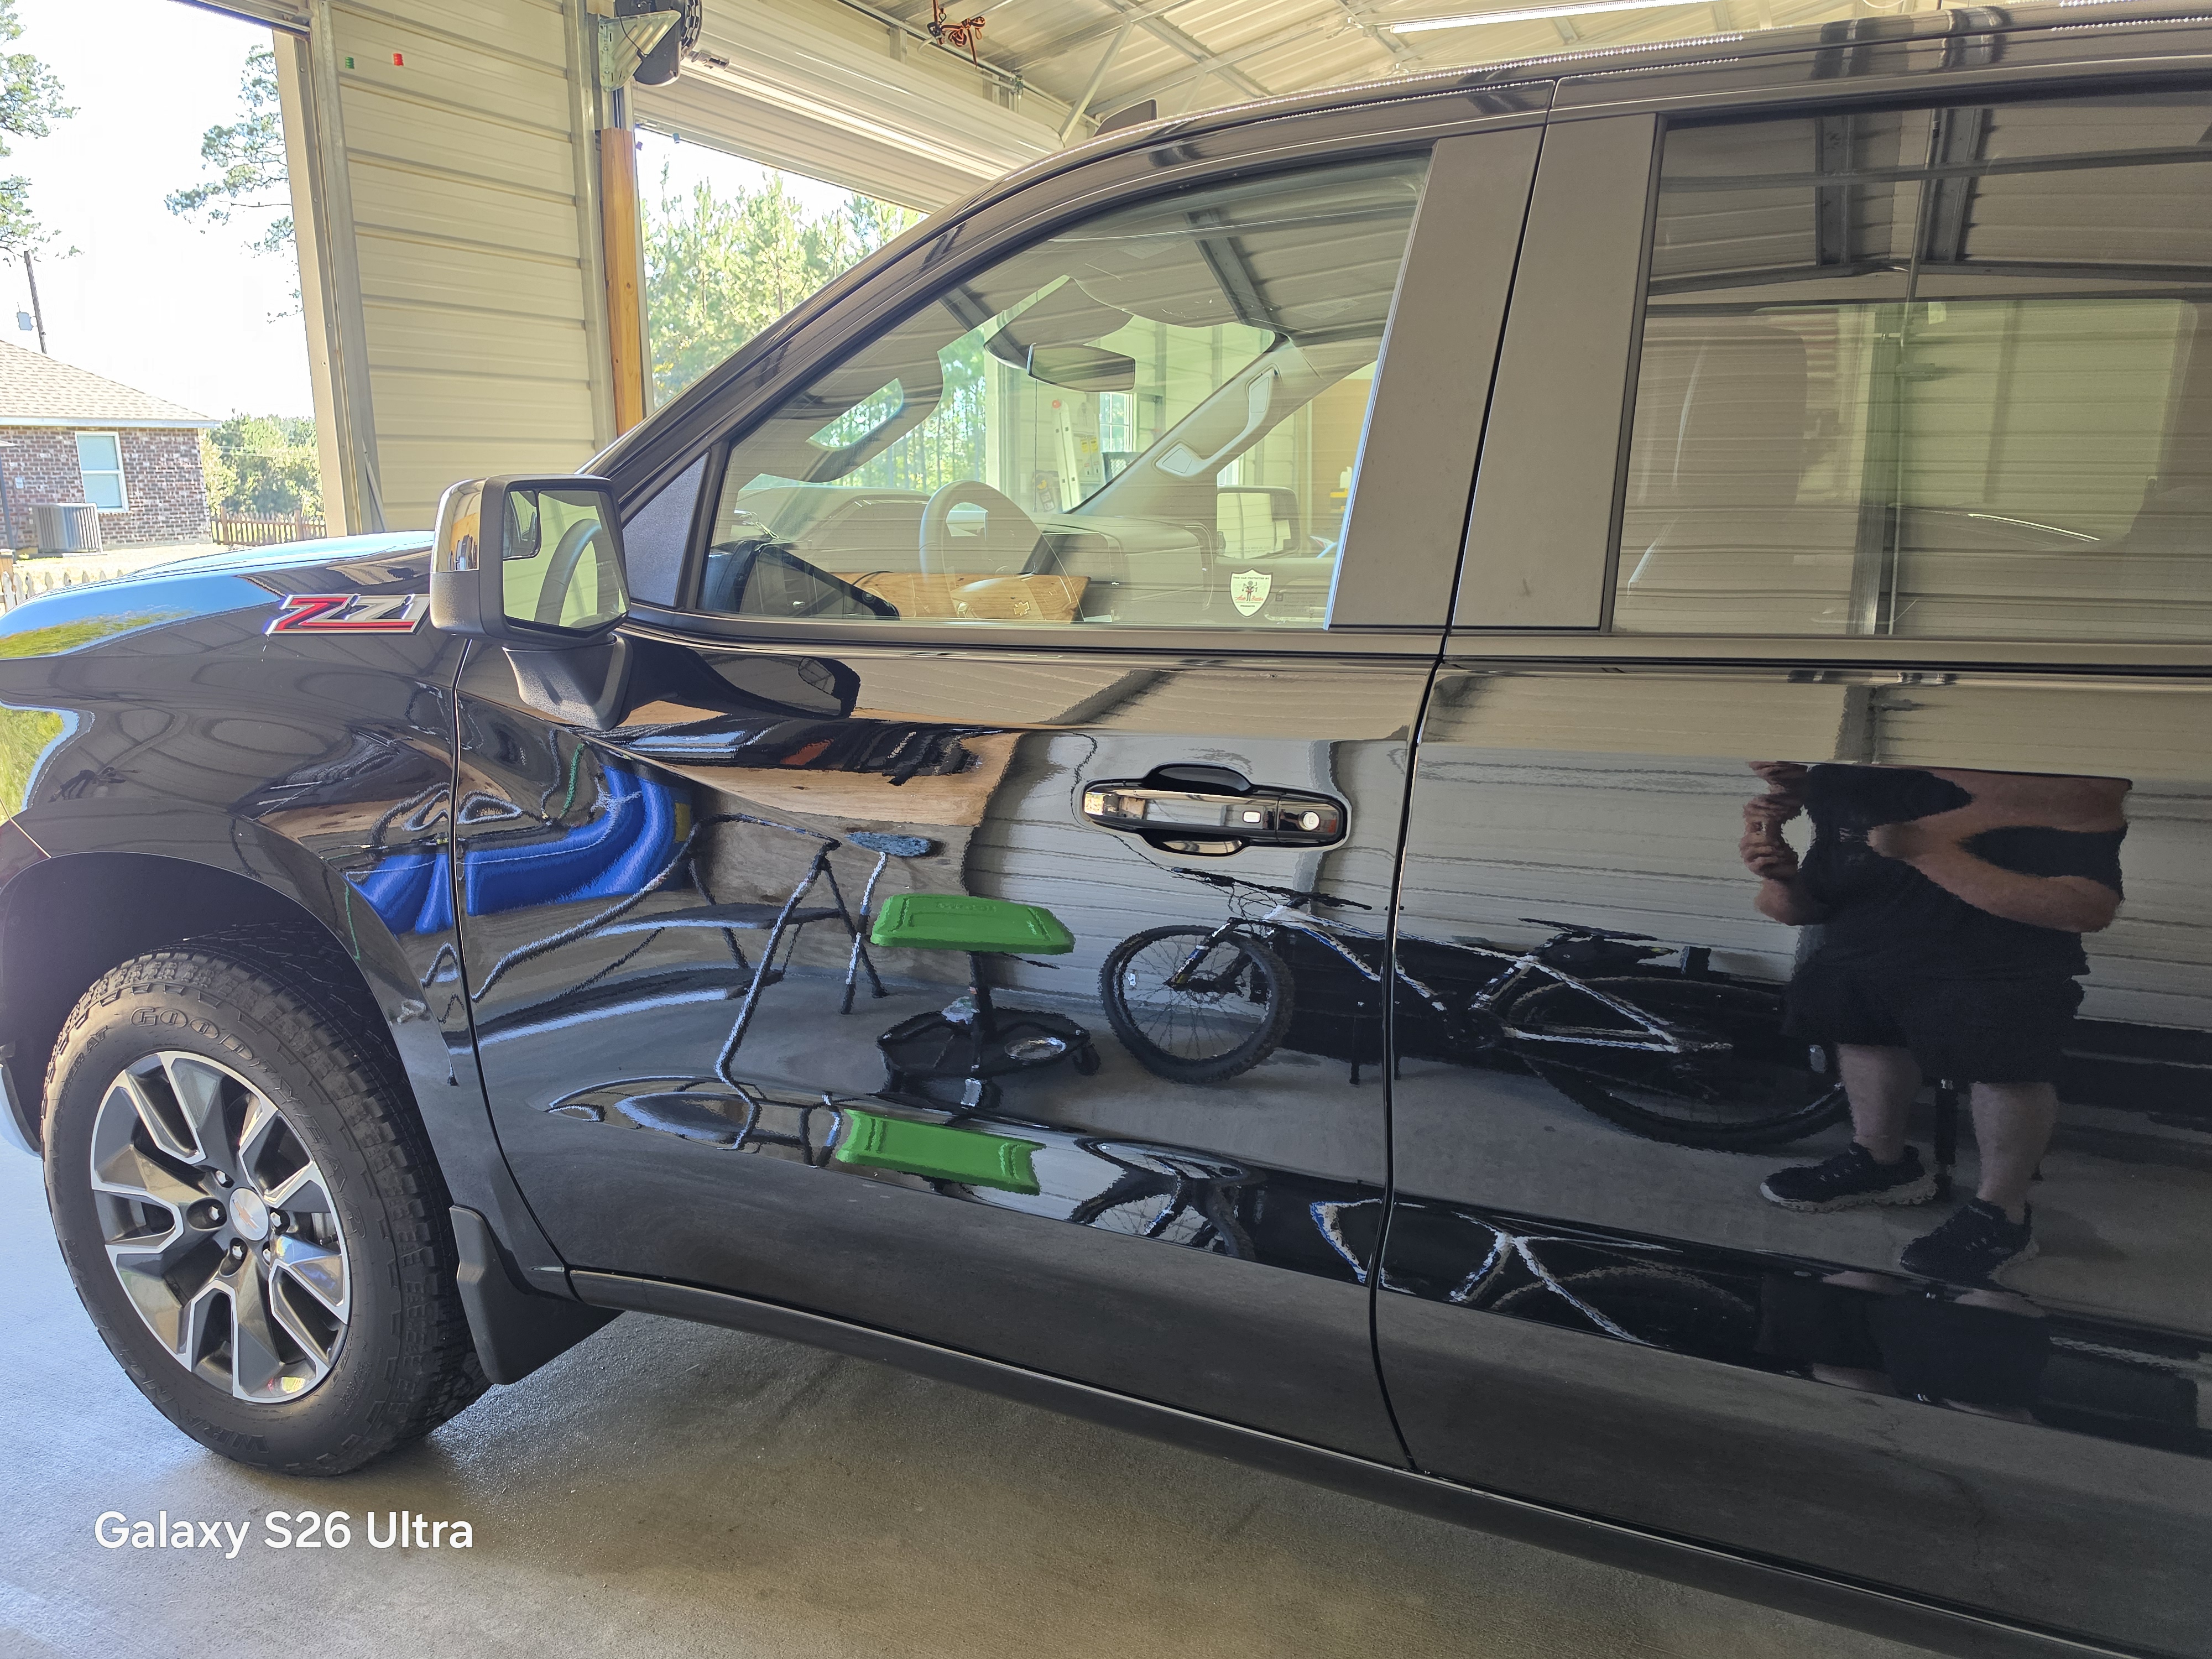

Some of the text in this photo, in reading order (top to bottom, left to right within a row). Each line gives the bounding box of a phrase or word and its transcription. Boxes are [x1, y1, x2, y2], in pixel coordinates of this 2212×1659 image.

[263, 593, 430, 634] Z71
[86, 1024, 109, 1054] AT
[131, 1007, 367, 1239] GOODYEAR
